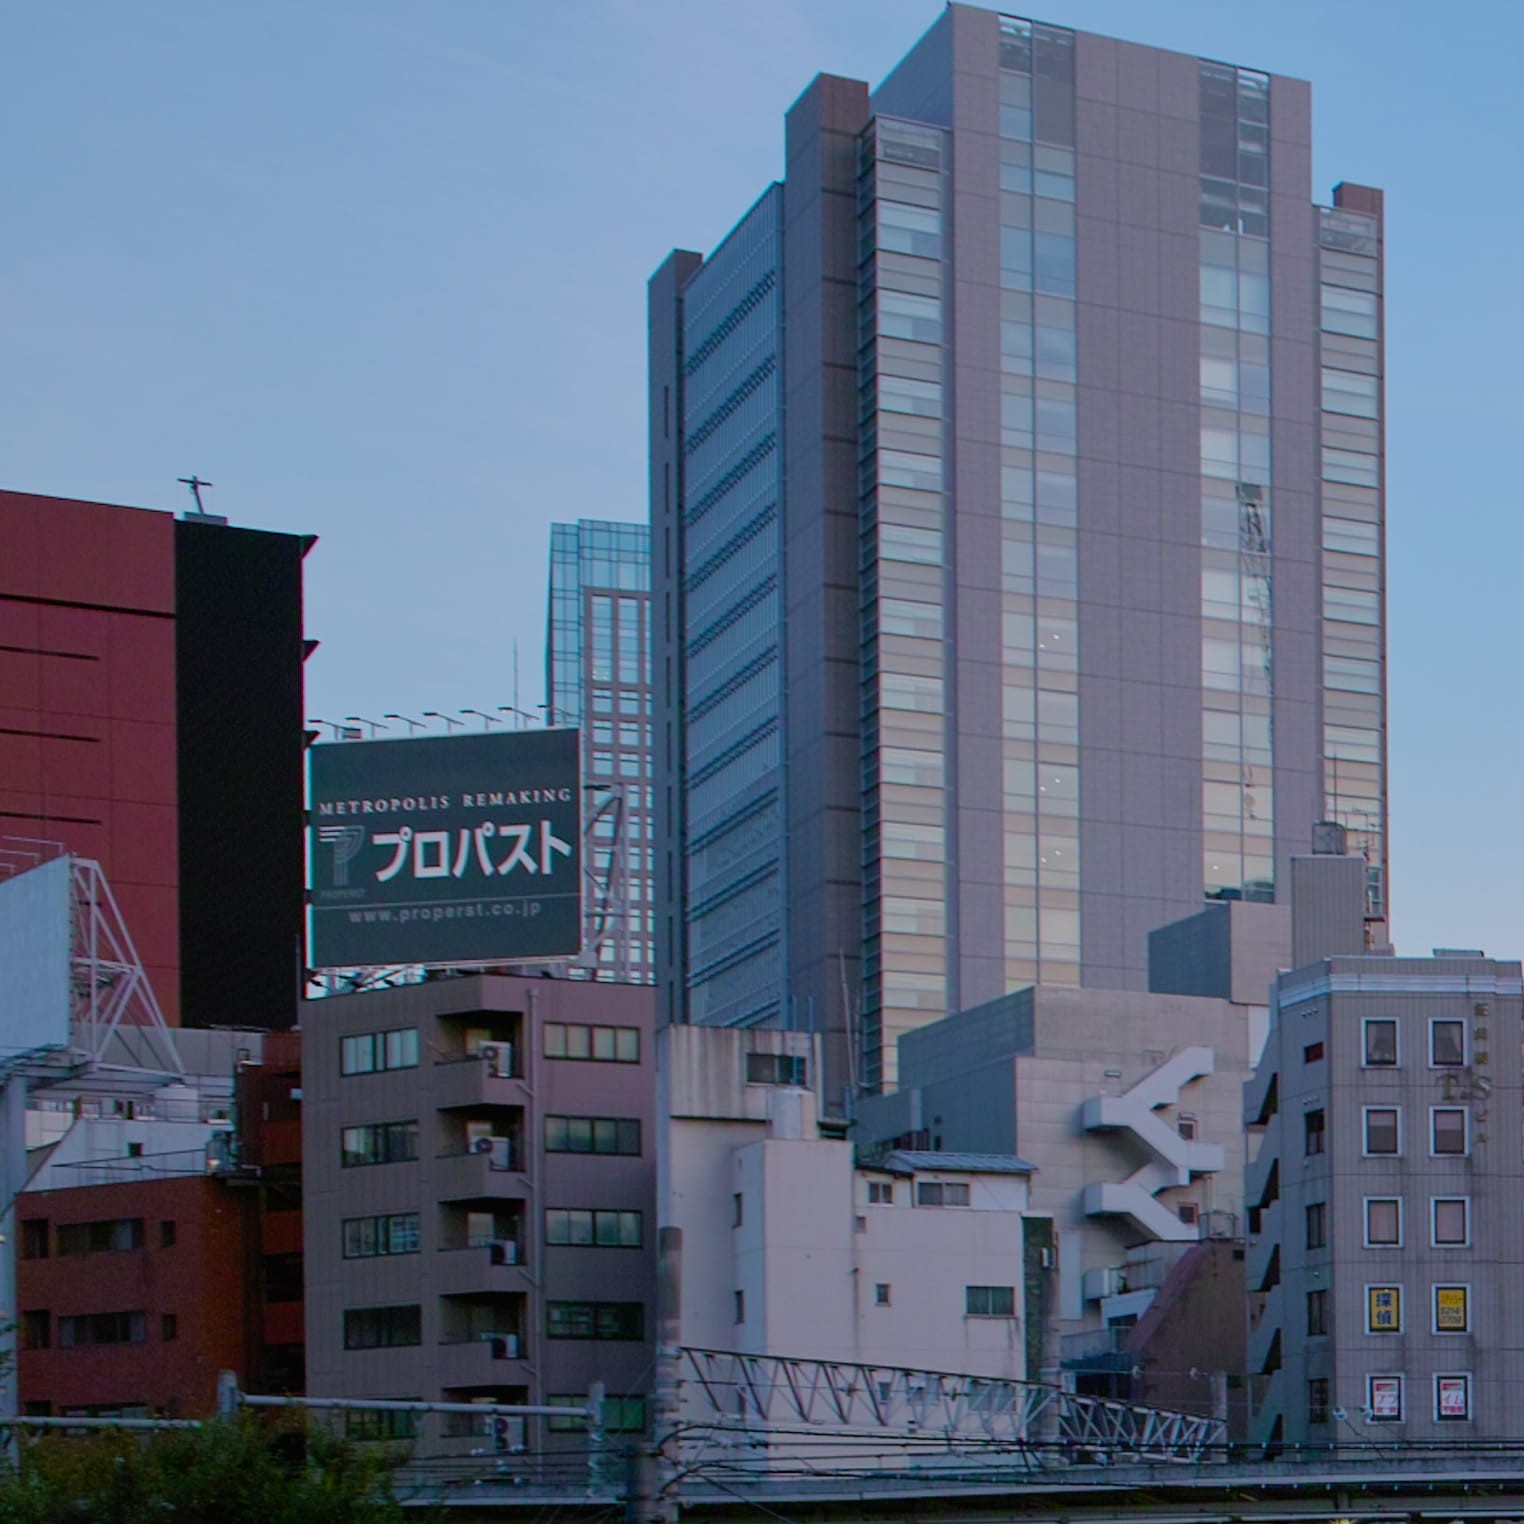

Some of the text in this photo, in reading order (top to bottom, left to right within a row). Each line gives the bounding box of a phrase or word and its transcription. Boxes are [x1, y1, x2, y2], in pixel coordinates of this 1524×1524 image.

[318, 788, 572, 816] METROPOLIS REMAKING
[372, 820, 572, 883] プロパスト
[349, 900, 541, 924] www.properst.co.jp
